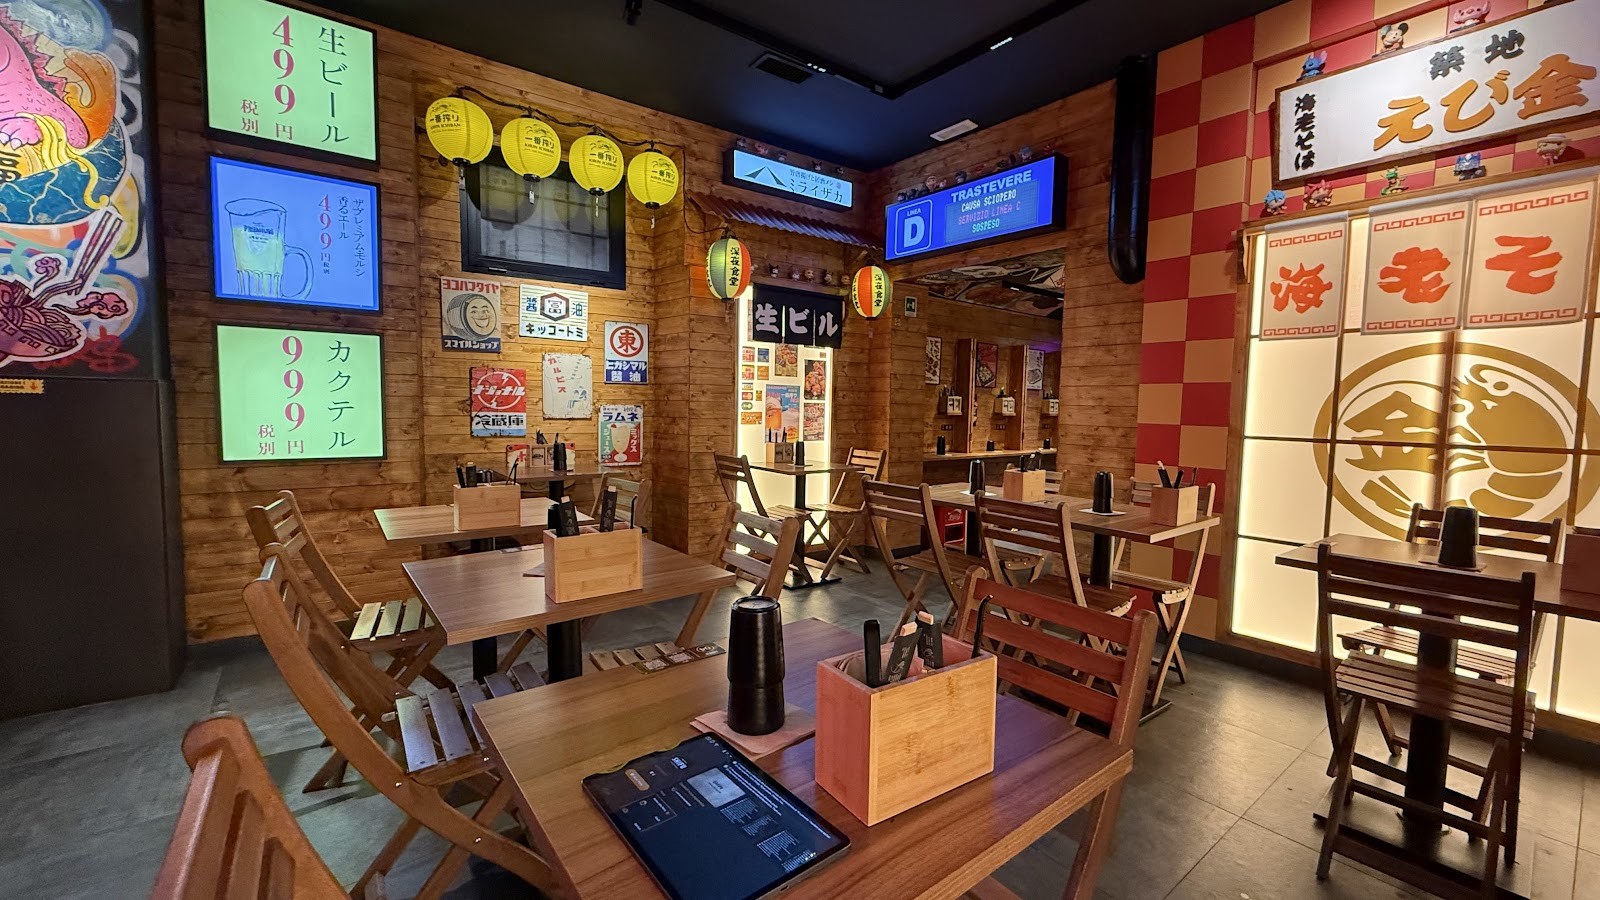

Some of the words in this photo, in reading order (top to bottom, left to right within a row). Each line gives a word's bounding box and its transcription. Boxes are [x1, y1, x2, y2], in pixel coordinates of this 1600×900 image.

[318, 27, 349, 142] 生ビール
[1373, 54, 1598, 151] えび金
[241, 99, 259, 133] 税別
[1294, 93, 1317, 171] 海老そば
[790, 178, 843, 203] ミライザカ
[950, 169, 1032, 203] TRASTEVERE
[907, 207, 922, 216] LINEA
[961, 199, 982, 212] CAUSA
[983, 189, 1017, 207] SCIOPERO
[957, 211, 988, 226] SERVIZIO
[990, 204, 1013, 218] LINEA
[971, 218, 1000, 233] SOSPESO
[903, 215, 925, 249] D
[525, 323, 583, 338] キッコートミ
[616, 329, 637, 354] 東
[606, 360, 648, 371] ヒガシマル
[328, 341, 355, 450] カクテル
[472, 384, 526, 396] ナショナル
[474, 414, 524, 427] 冷蔵庫
[602, 412, 639, 422] ラムネ
[258, 424, 275, 456] 税別
